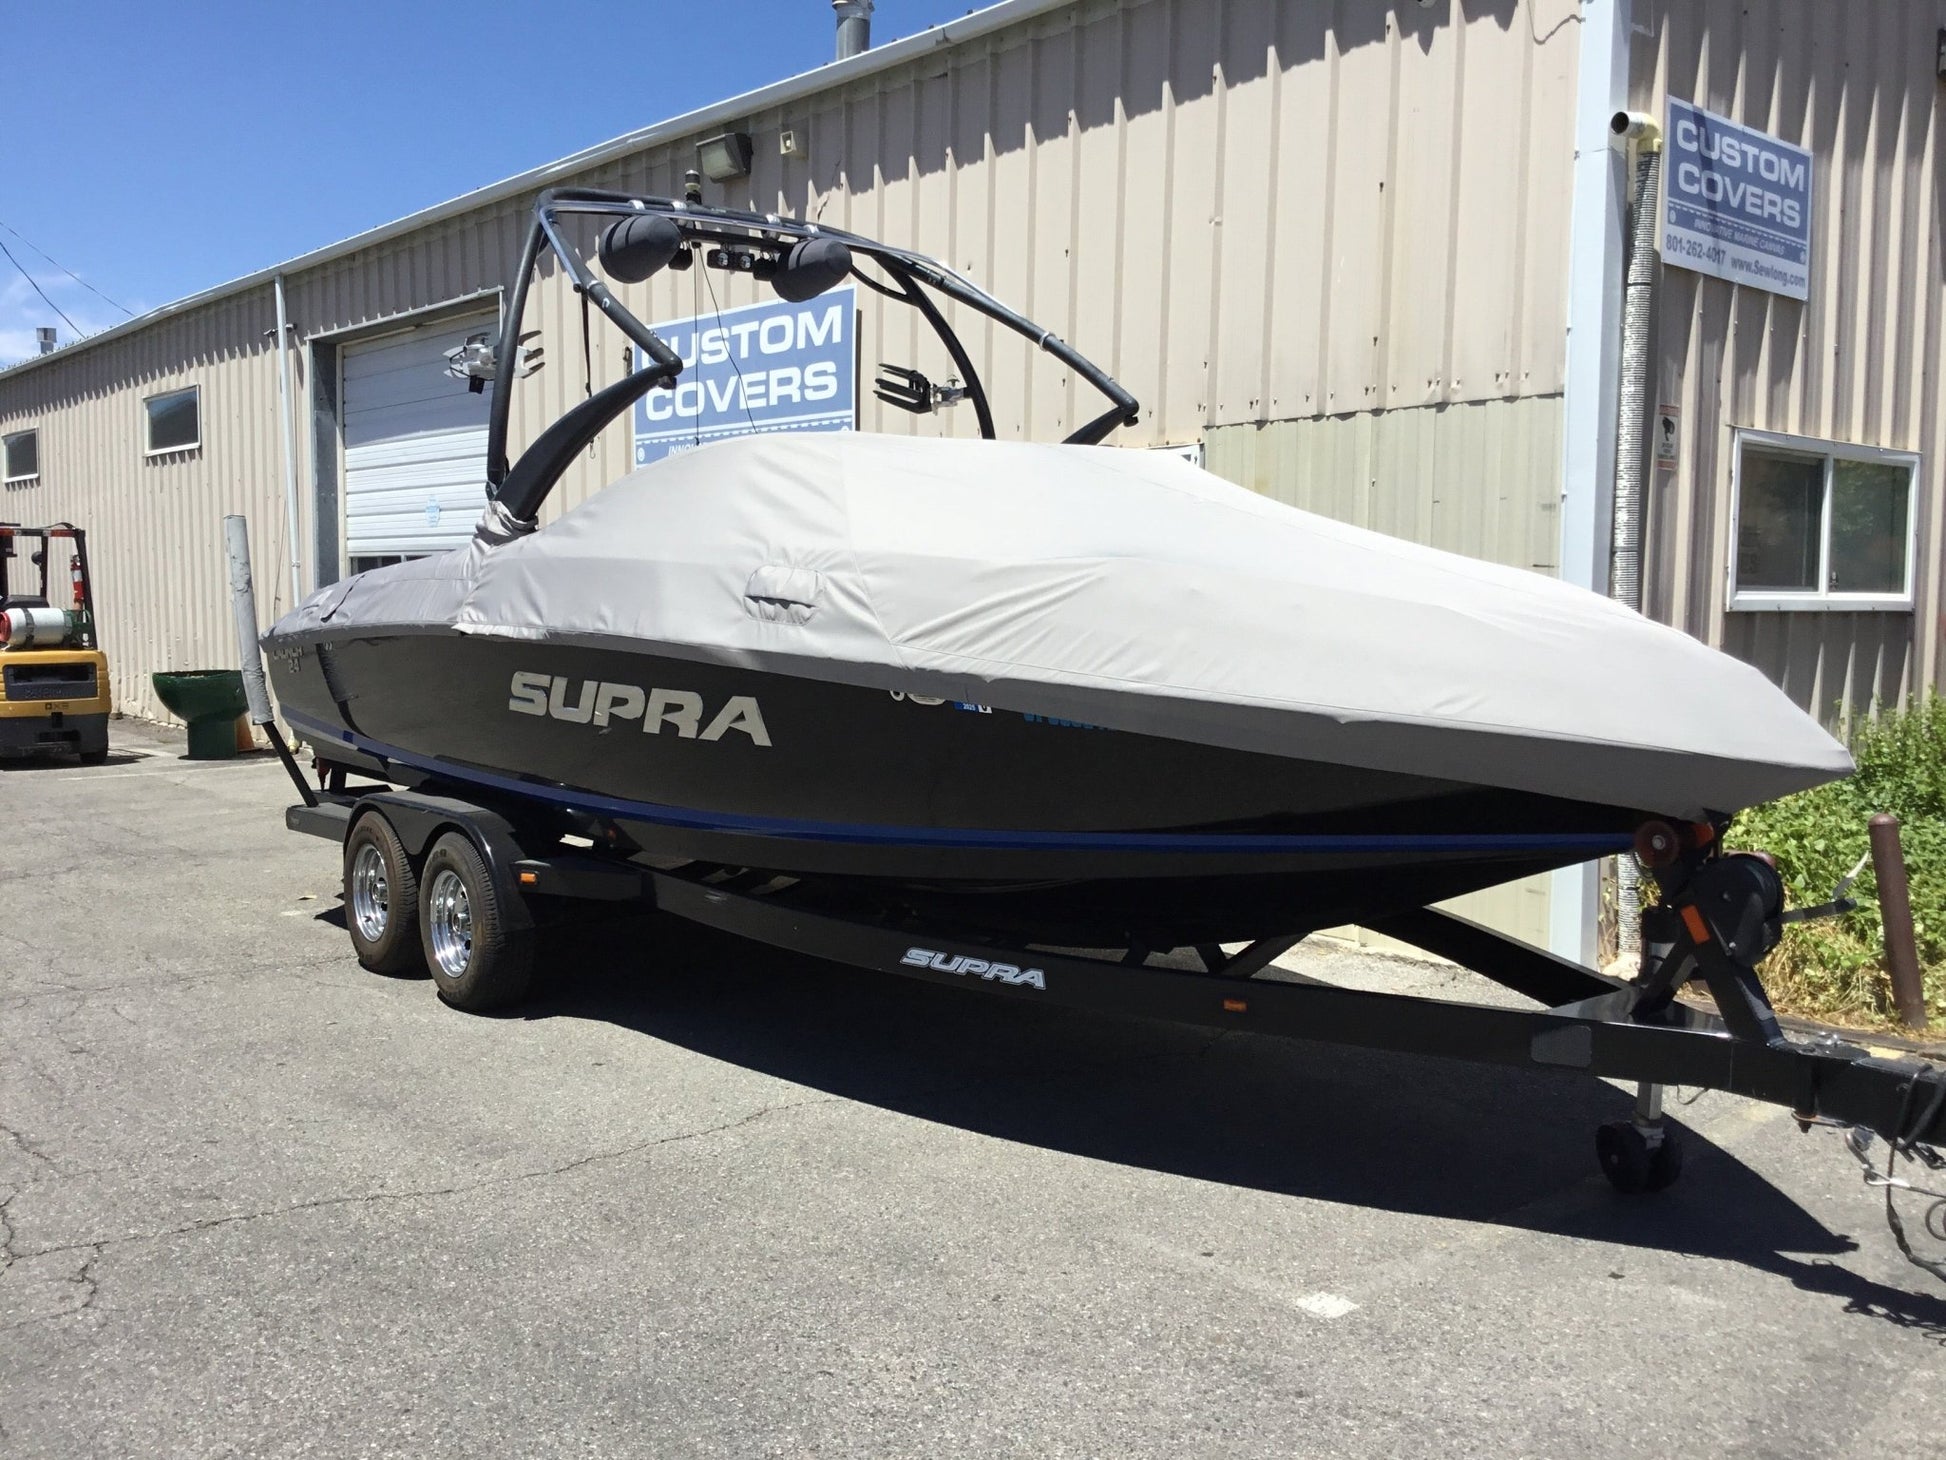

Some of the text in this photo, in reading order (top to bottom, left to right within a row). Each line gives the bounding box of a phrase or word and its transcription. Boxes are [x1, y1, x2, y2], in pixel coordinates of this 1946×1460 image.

[1676, 119, 1804, 192] CUSTOM
[1678, 162, 1800, 229] COVERS
[1666, 234, 1806, 289] 801-262-4017 www.Sewlong.com
[645, 361, 838, 421] COVERS
[508, 670, 772, 747] SUPRA
[900, 947, 1046, 990] SUPRA
